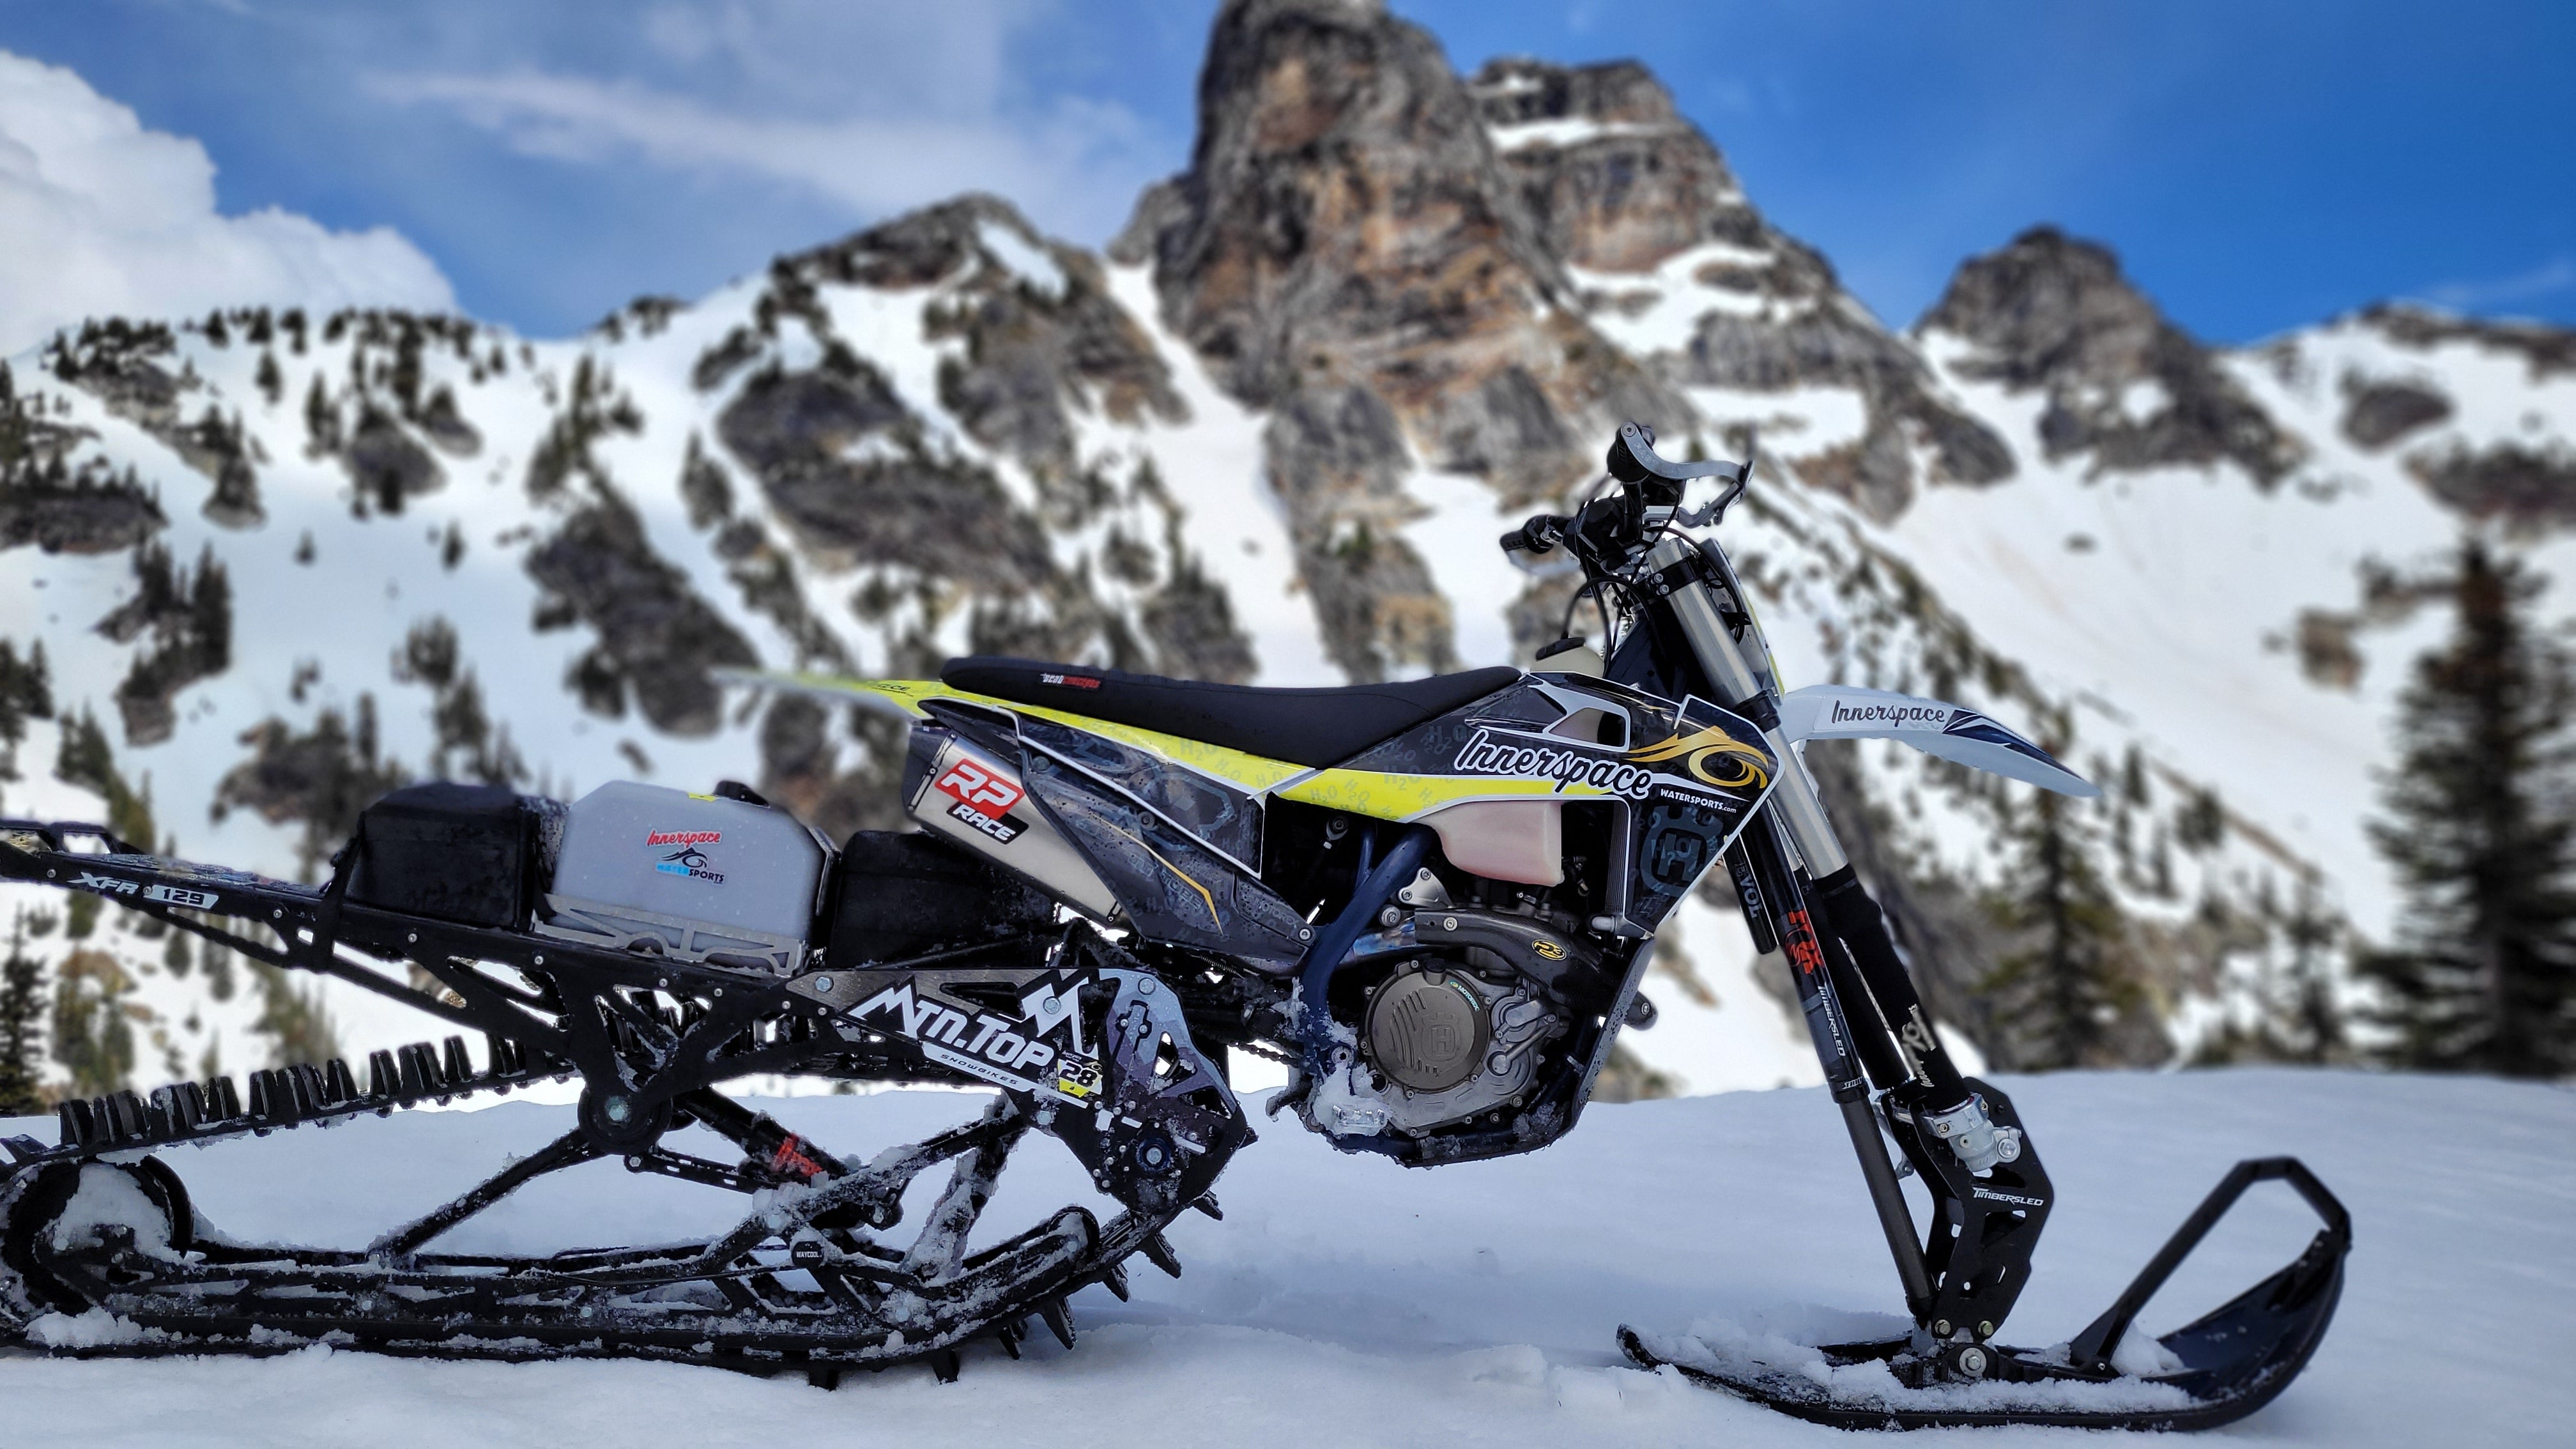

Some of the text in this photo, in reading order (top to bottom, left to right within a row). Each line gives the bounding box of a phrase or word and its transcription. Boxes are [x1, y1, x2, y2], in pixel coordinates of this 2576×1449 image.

[1832, 700, 1944, 727] Innerspace
[1456, 730, 1653, 798] Innerspace
[940, 764, 1018, 806] RP
[953, 804, 1016, 841] RACE
[647, 830, 721, 848] Innerspace
[67, 871, 205, 905] XFR 129
[1818, 982, 1846, 1056] TIMBERSLED
[940, 1054, 1018, 1085] SNOWBIKES
[1059, 1061, 1098, 1088] 28
[1973, 1187, 2044, 1206] TIMBERSLED
